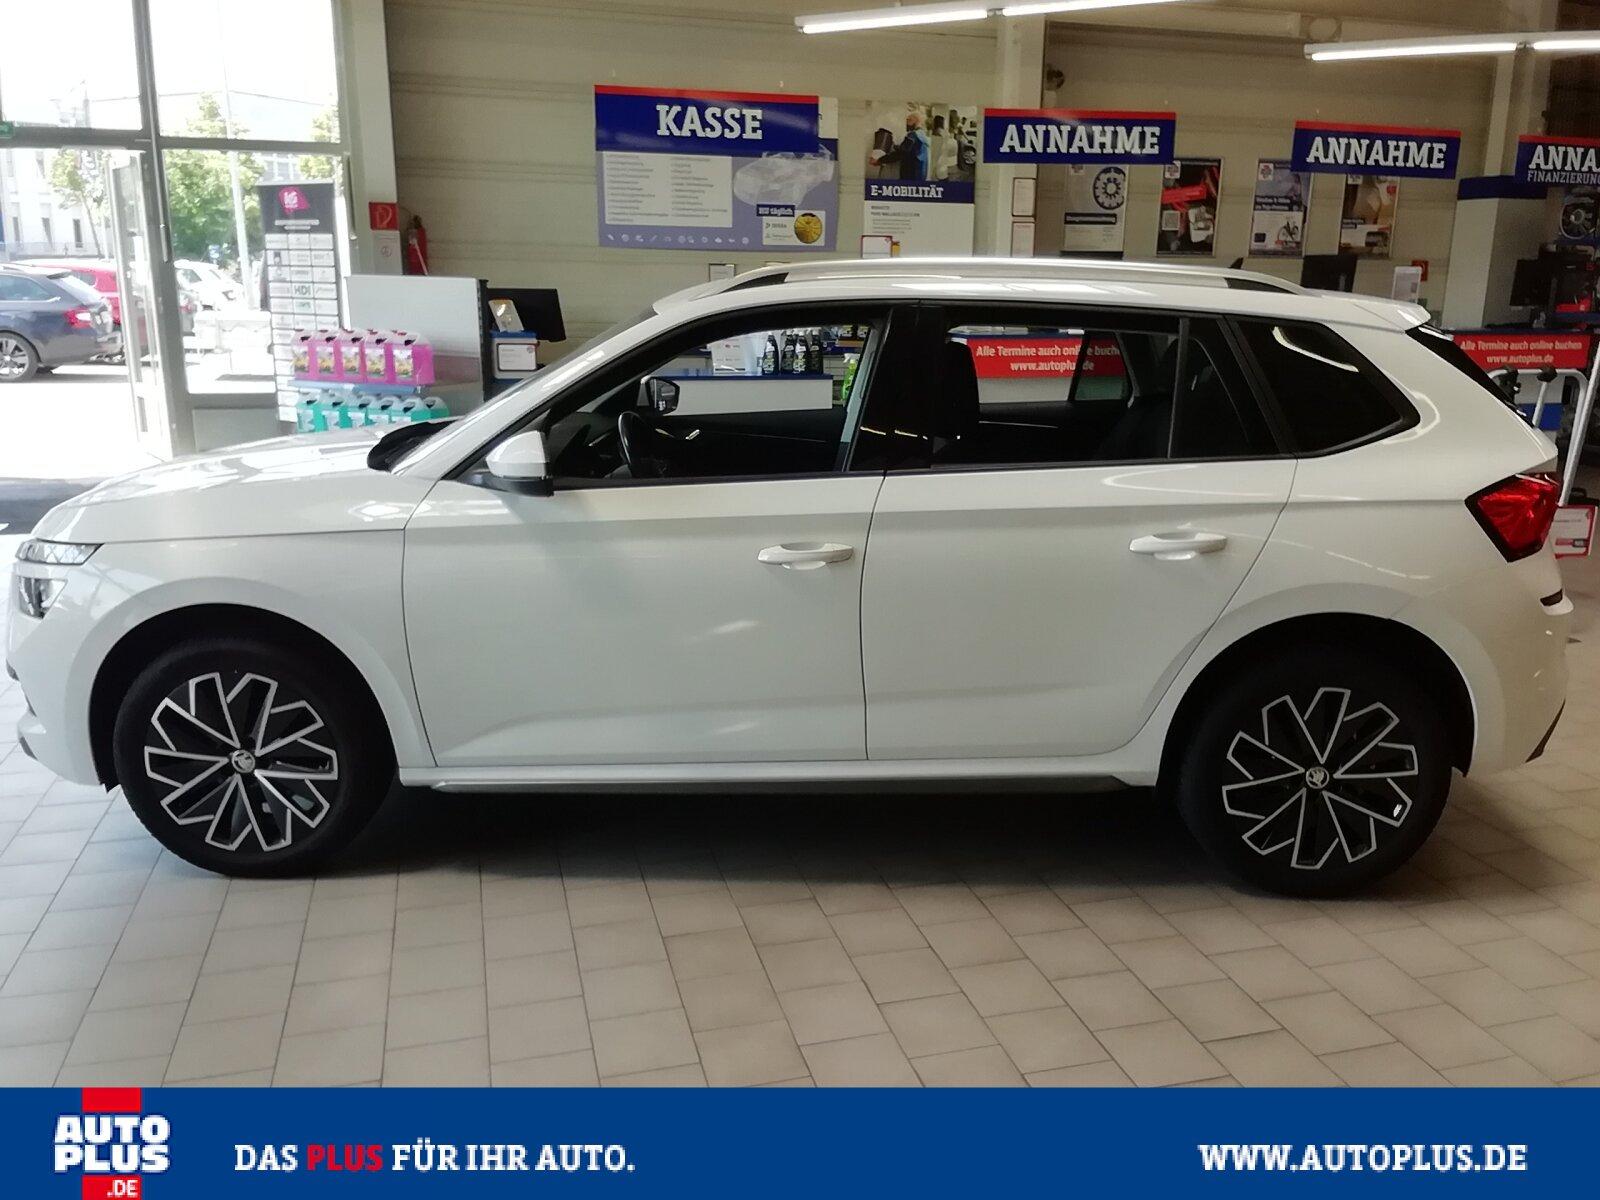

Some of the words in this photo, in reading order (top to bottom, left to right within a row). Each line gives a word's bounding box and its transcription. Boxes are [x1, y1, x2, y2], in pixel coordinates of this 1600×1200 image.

[656, 104, 763, 140] KASSE
[999, 124, 1161, 155] ANNAHME
[1306, 136, 1447, 169] ANNAHME
[1528, 144, 1600, 172] ANNA
[870, 184, 944, 198] E-MOBILITÄT
[976, 345, 996, 357] Alle
[997, 345, 1037, 357] Termine
[1038, 345, 1061, 356] auch
[1062, 345, 1093, 356] onlie
[1094, 345, 1121, 356] buch
[1477, 340, 1509, 351] Termine
[1510, 340, 1529, 351] auch
[1530, 341, 1554, 351] online
[1555, 341, 1583, 351] buchen
[1486, 354, 1555, 364] www.autoplus.de
